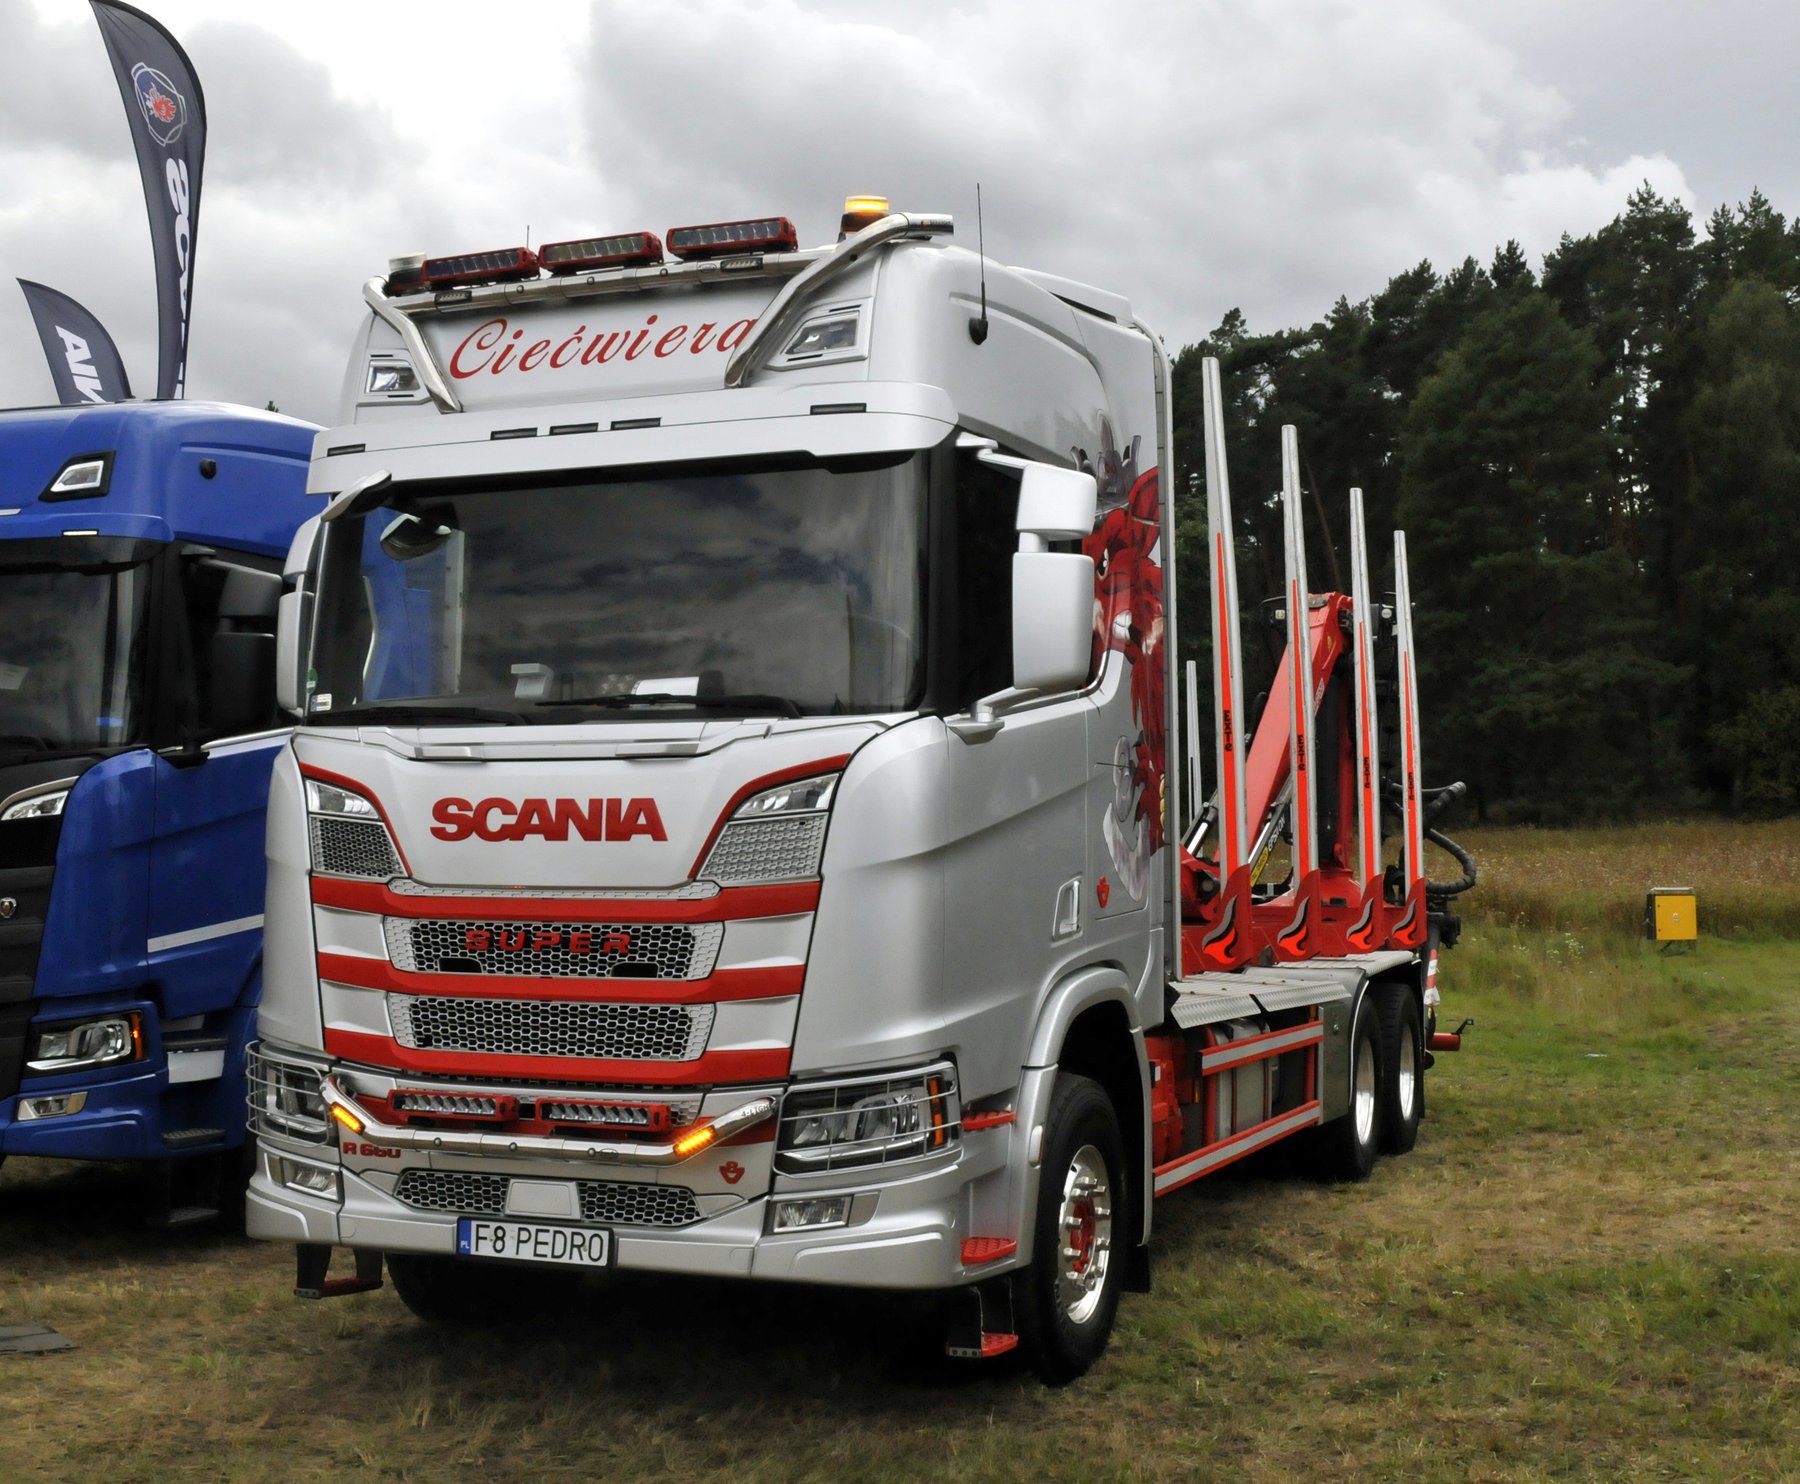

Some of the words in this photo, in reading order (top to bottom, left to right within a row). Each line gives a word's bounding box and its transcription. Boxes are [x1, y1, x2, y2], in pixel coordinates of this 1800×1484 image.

[450, 314, 757, 379] Ciećwiera
[430, 797, 668, 842] SCANIA
[464, 929, 632, 954] SUPER
[342, 1142, 357, 1155] R
[460, 1240, 470, 1249] PL
[475, 1223, 506, 1254] F8
[516, 1226, 604, 1262] PEDRO
